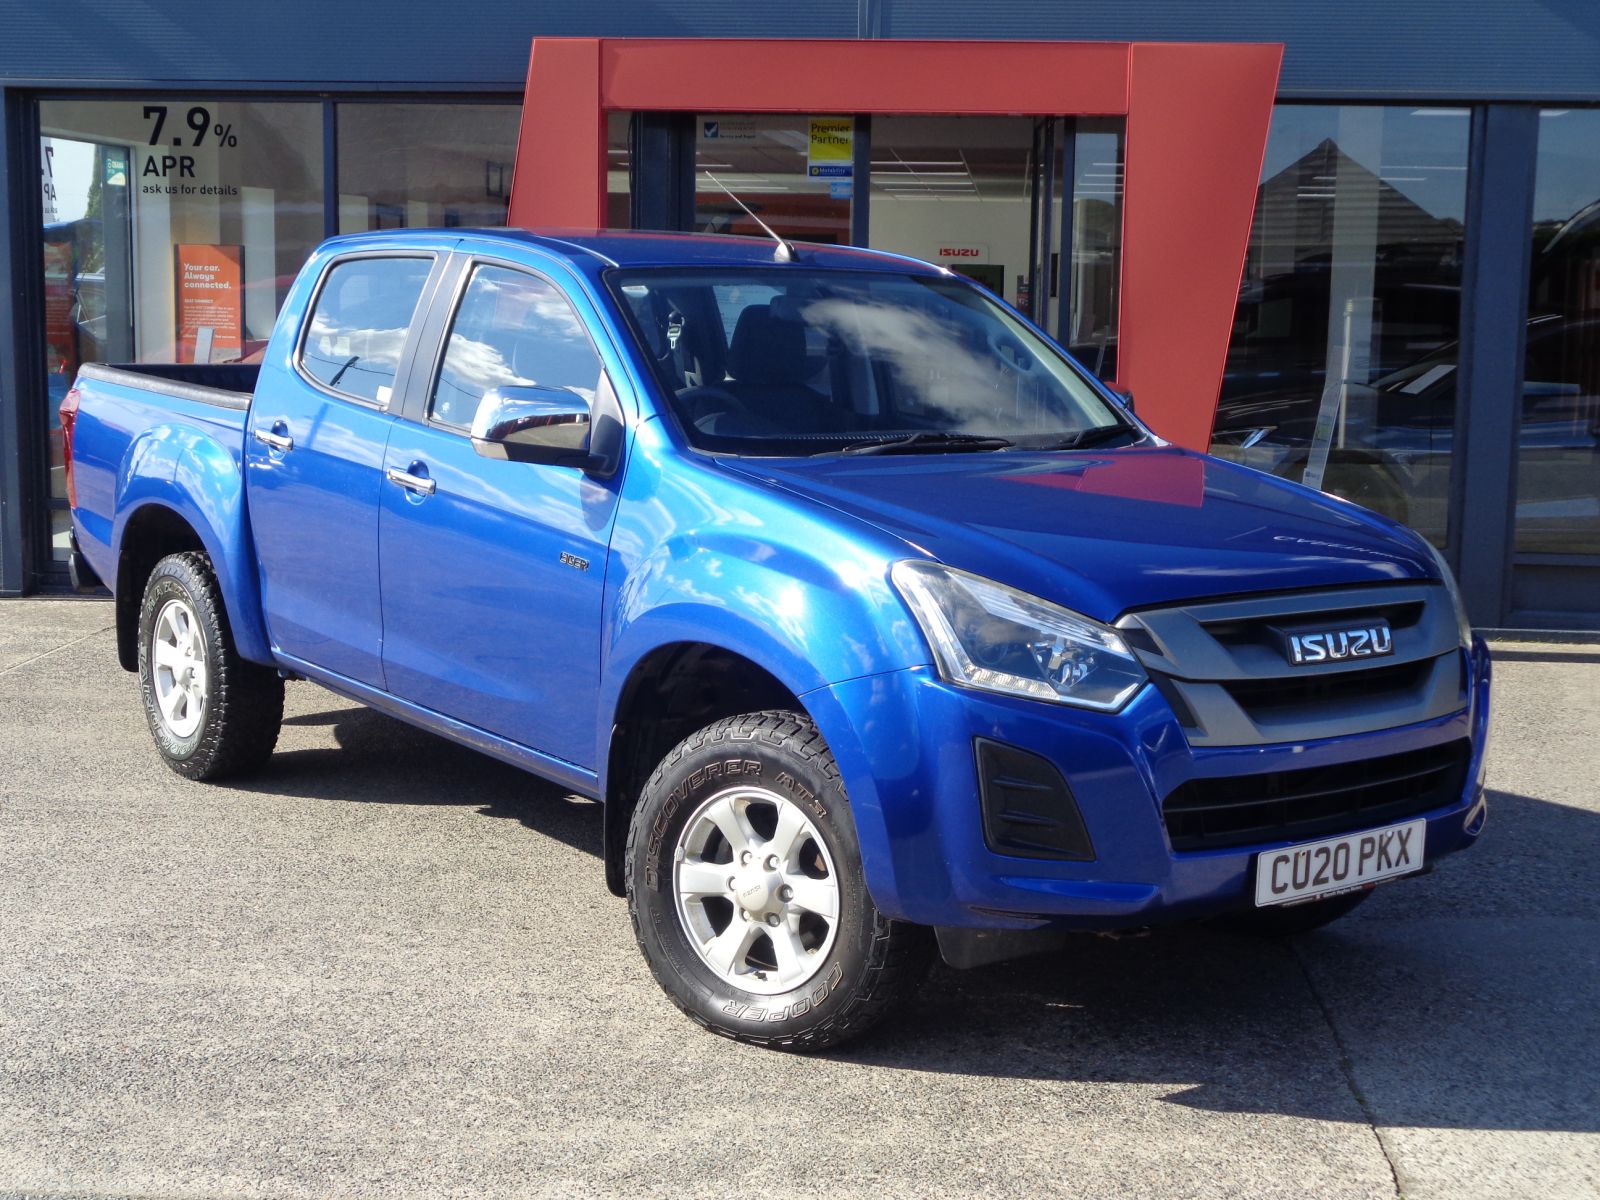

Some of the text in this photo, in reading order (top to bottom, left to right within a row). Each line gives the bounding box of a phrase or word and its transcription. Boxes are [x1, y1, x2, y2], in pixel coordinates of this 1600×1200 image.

[143, 106, 237, 148] 7.9%
[811, 123, 850, 133] Premier
[811, 134, 849, 145] Partner
[143, 155, 195, 178] APR
[142, 184, 238, 196] ask us for details
[939, 248, 979, 257] ISUZU
[184, 263, 221, 272] Your car.
[184, 272, 215, 282] Always
[184, 281, 232, 290] connected.
[1290, 626, 1392, 663] ISUZU
[645, 758, 828, 892] DISCOVERER AT3
[1271, 827, 1413, 895] CU20 PKX
[719, 960, 844, 1023] COOPER
